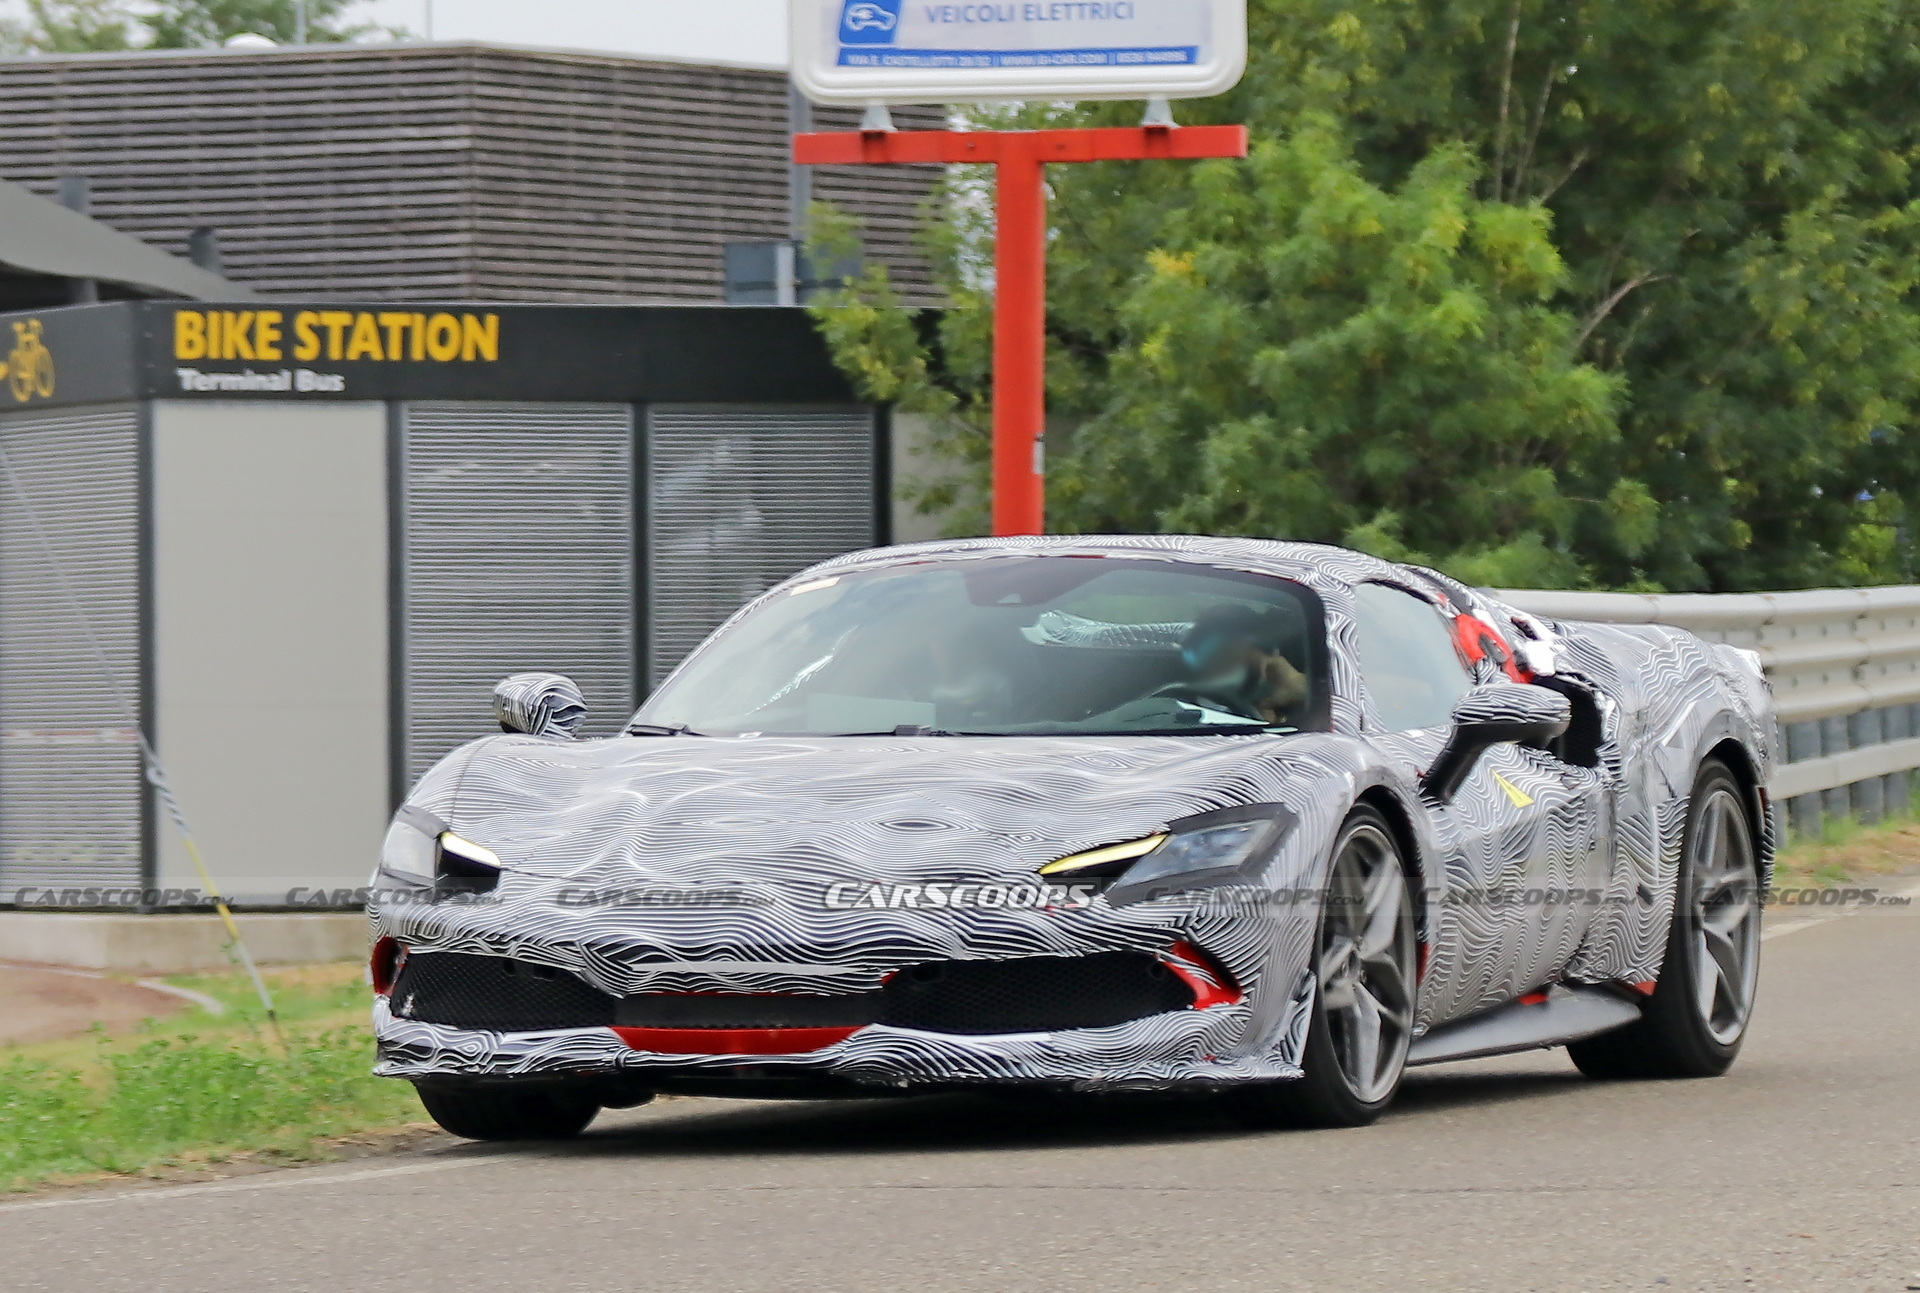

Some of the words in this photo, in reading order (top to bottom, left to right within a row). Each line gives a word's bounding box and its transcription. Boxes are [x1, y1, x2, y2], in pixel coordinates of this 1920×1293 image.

[925, 4, 1015, 23] VEICOLI
[1023, 1, 1135, 21] ELETTRICI
[175, 310, 283, 360] BIKE
[293, 310, 499, 361] STATION
[175, 366, 292, 391] Terminal
[294, 368, 346, 392] Bus
